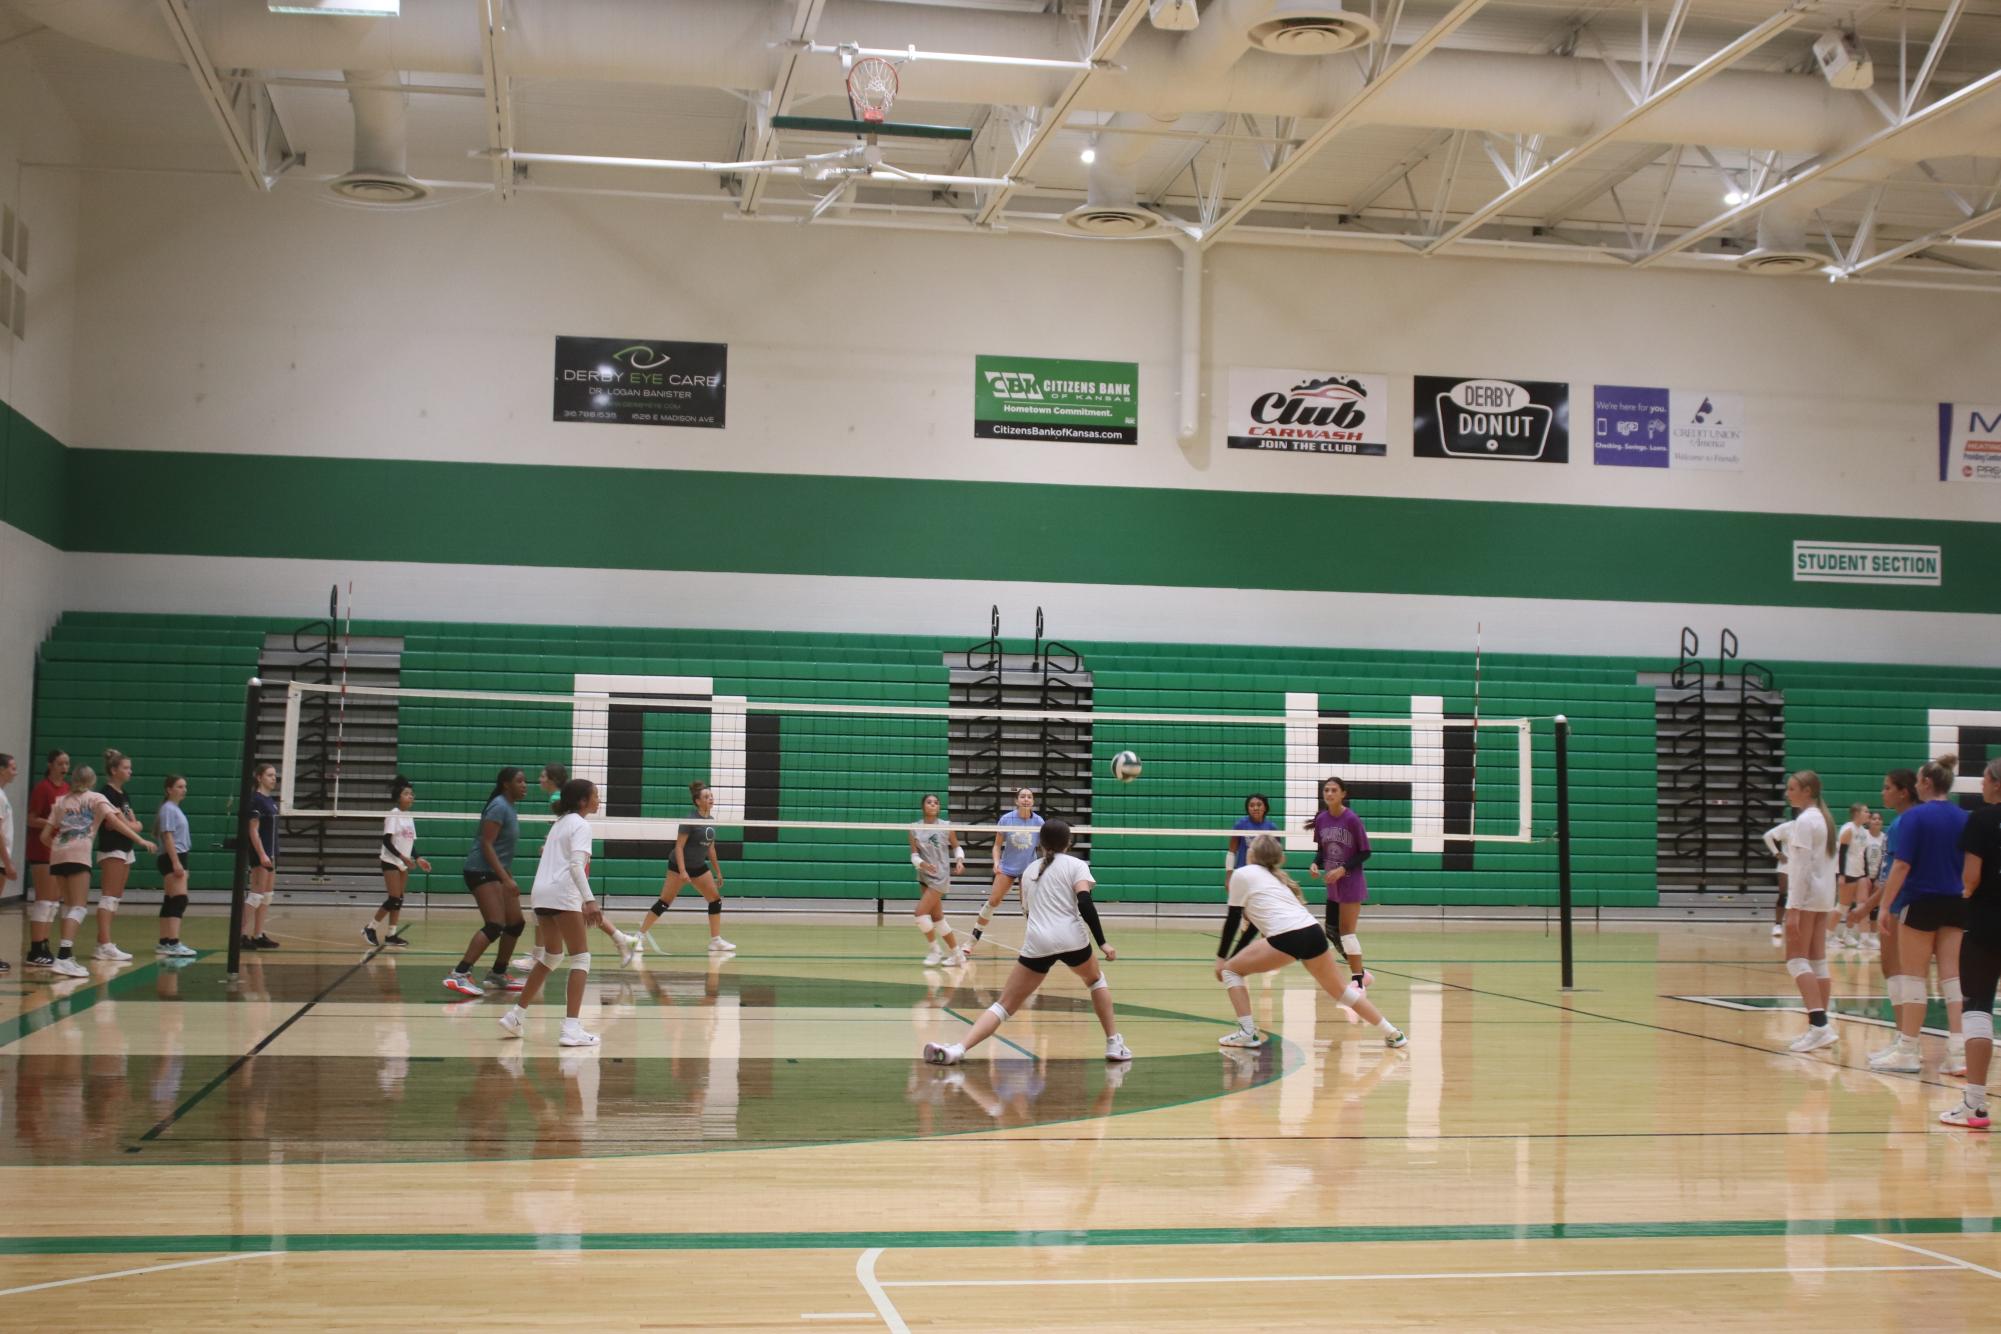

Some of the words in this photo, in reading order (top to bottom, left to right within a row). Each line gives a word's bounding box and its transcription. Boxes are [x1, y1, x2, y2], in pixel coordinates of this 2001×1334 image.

[564, 369, 624, 383] DERBY
[630, 372, 664, 385] EYE
[669, 374, 720, 388] CARE
[607, 388, 641, 397] LOGAN
[643, 389, 692, 399] BANISTER
[1043, 379, 1096, 394] CITIZENS
[1099, 382, 1131, 396] BANK
[1075, 394, 1131, 403] KANSAS
[1465, 385, 1516, 408] DERBY
[1003, 404, 1051, 415] Hometown
[1053, 406, 1113, 417] Commitment.
[1250, 392, 1366, 430] Club
[1619, 402, 1637, 412] here
[1638, 403, 1648, 412] for
[660, 413, 697, 422] MADISON
[1458, 413, 1534, 437] DONUT
[993, 425, 1123, 440] CitizensBankofKansas.com
[1248, 426, 1364, 441] CARWASH
[1258, 439, 1288, 449] JOIN
[1292, 441, 1316, 451] THE
[1797, 553, 1868, 571] STUDENT
[1871, 555, 1937, 573] SECTION
